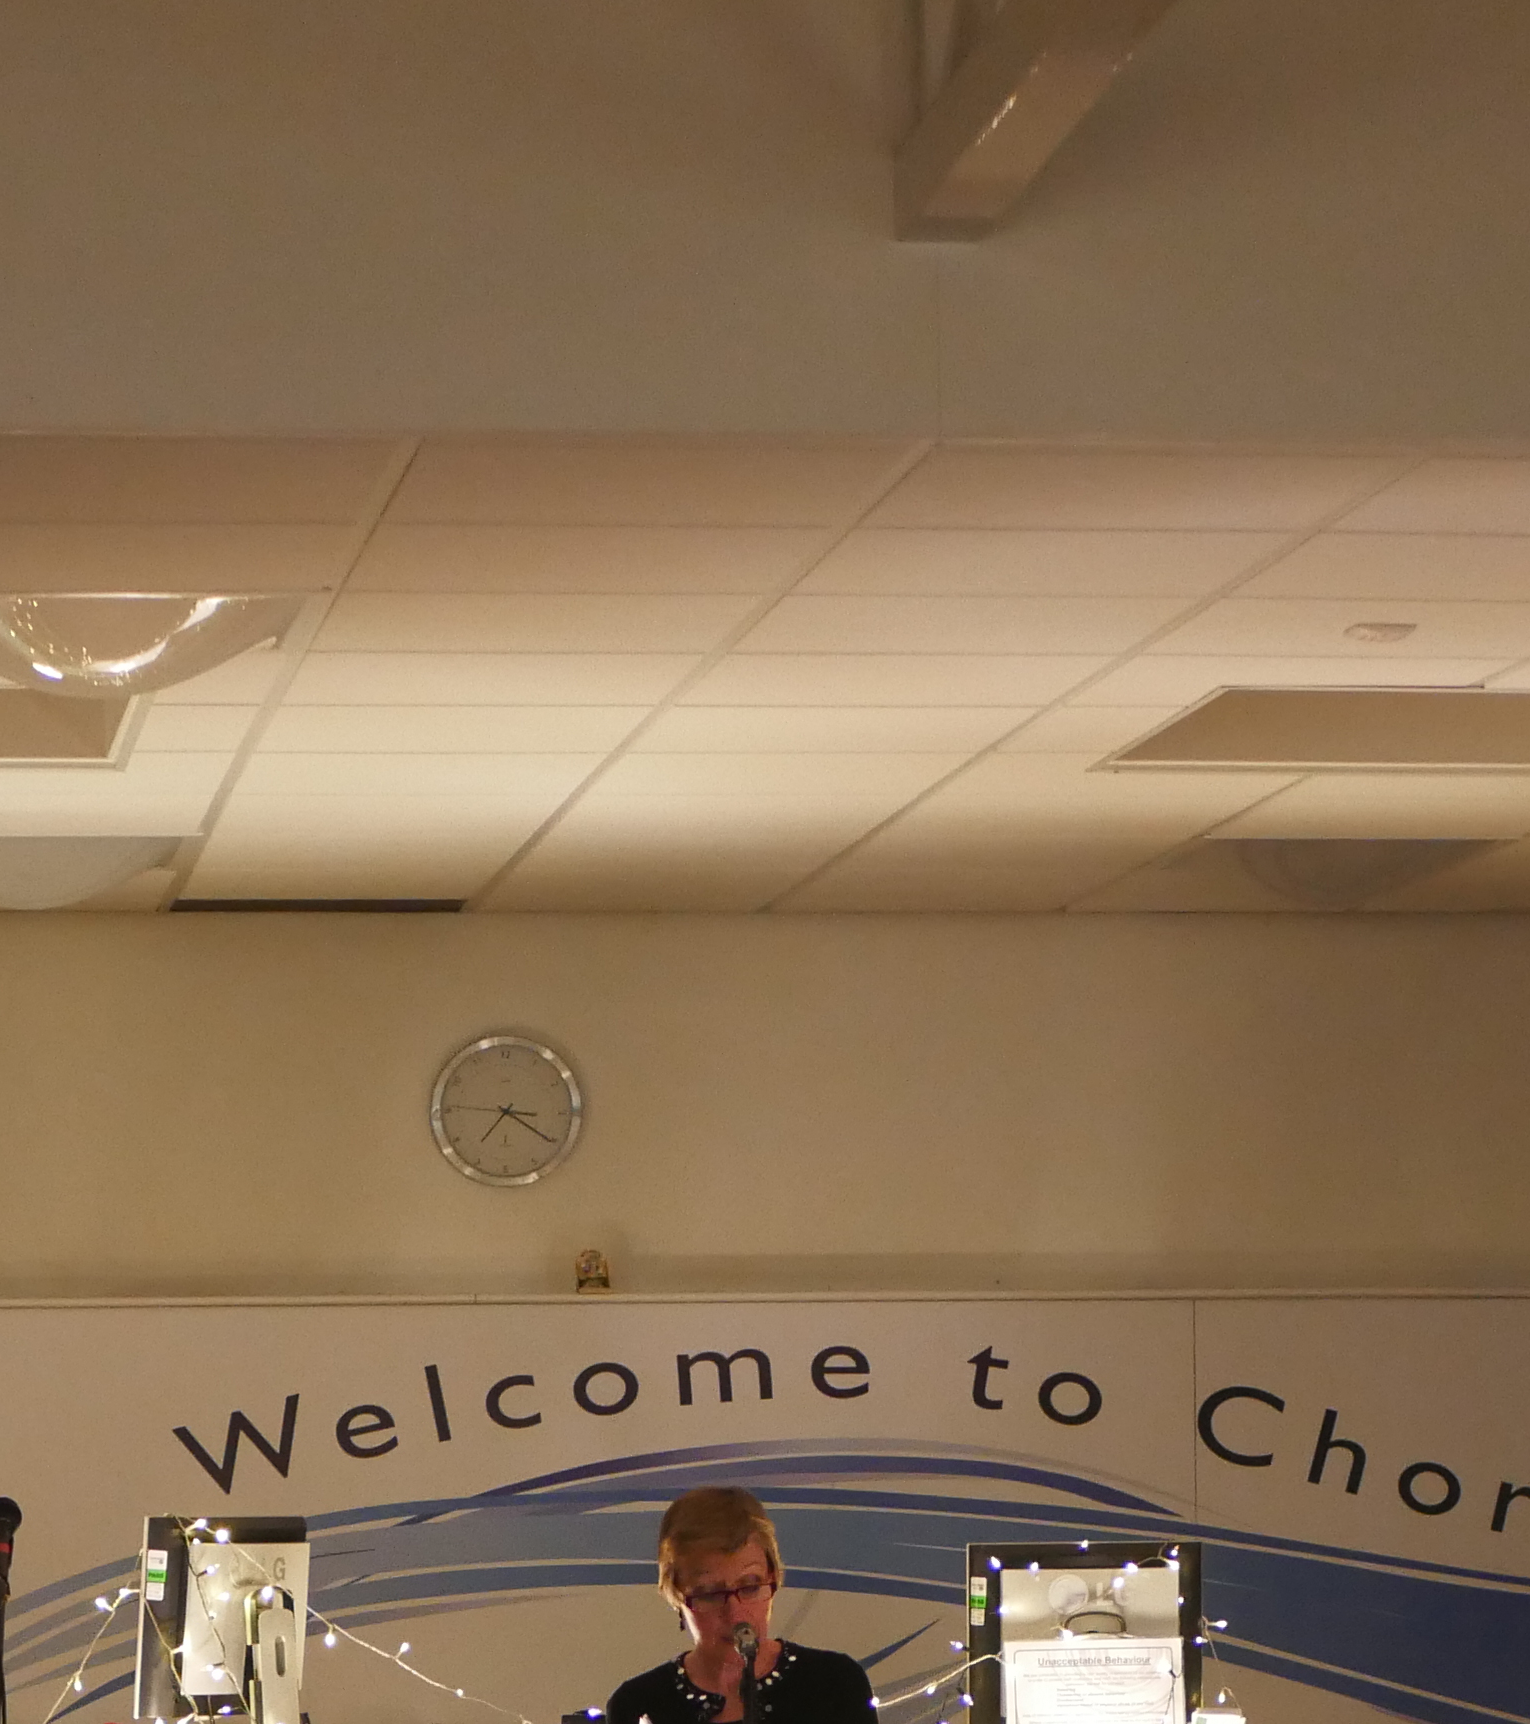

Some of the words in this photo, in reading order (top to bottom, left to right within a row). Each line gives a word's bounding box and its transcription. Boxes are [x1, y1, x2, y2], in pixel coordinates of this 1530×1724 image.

[172, 1345, 870, 1495] Welcome
[967, 1345, 1103, 1426] to
[1037, 1657, 1102, 1667] Unacceptable
[1104, 1655, 1152, 1666] Behaviour
